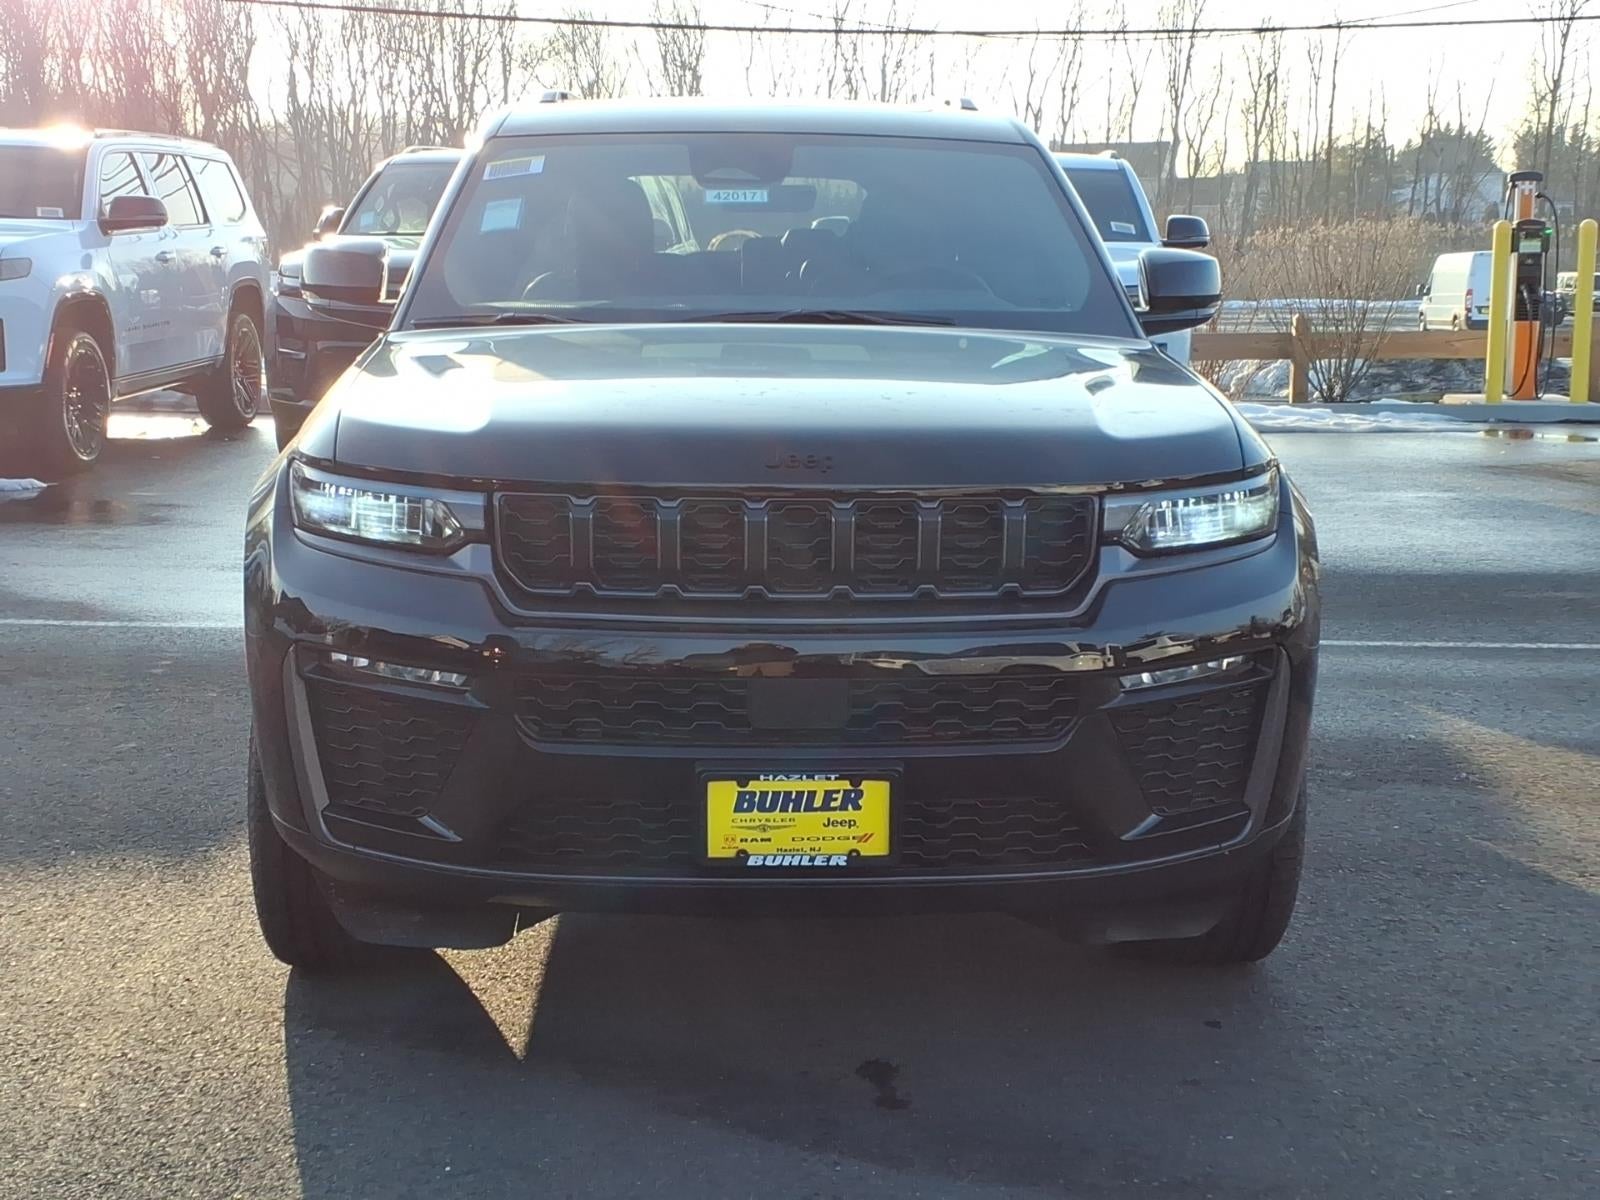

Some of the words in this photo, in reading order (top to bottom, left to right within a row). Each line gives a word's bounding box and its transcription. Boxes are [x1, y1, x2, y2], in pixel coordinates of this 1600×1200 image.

[713, 191, 758, 201] 42017
[733, 788, 864, 813] BUHLER
[822, 817, 857, 829] Jeep
[746, 855, 848, 866] BUHLER
